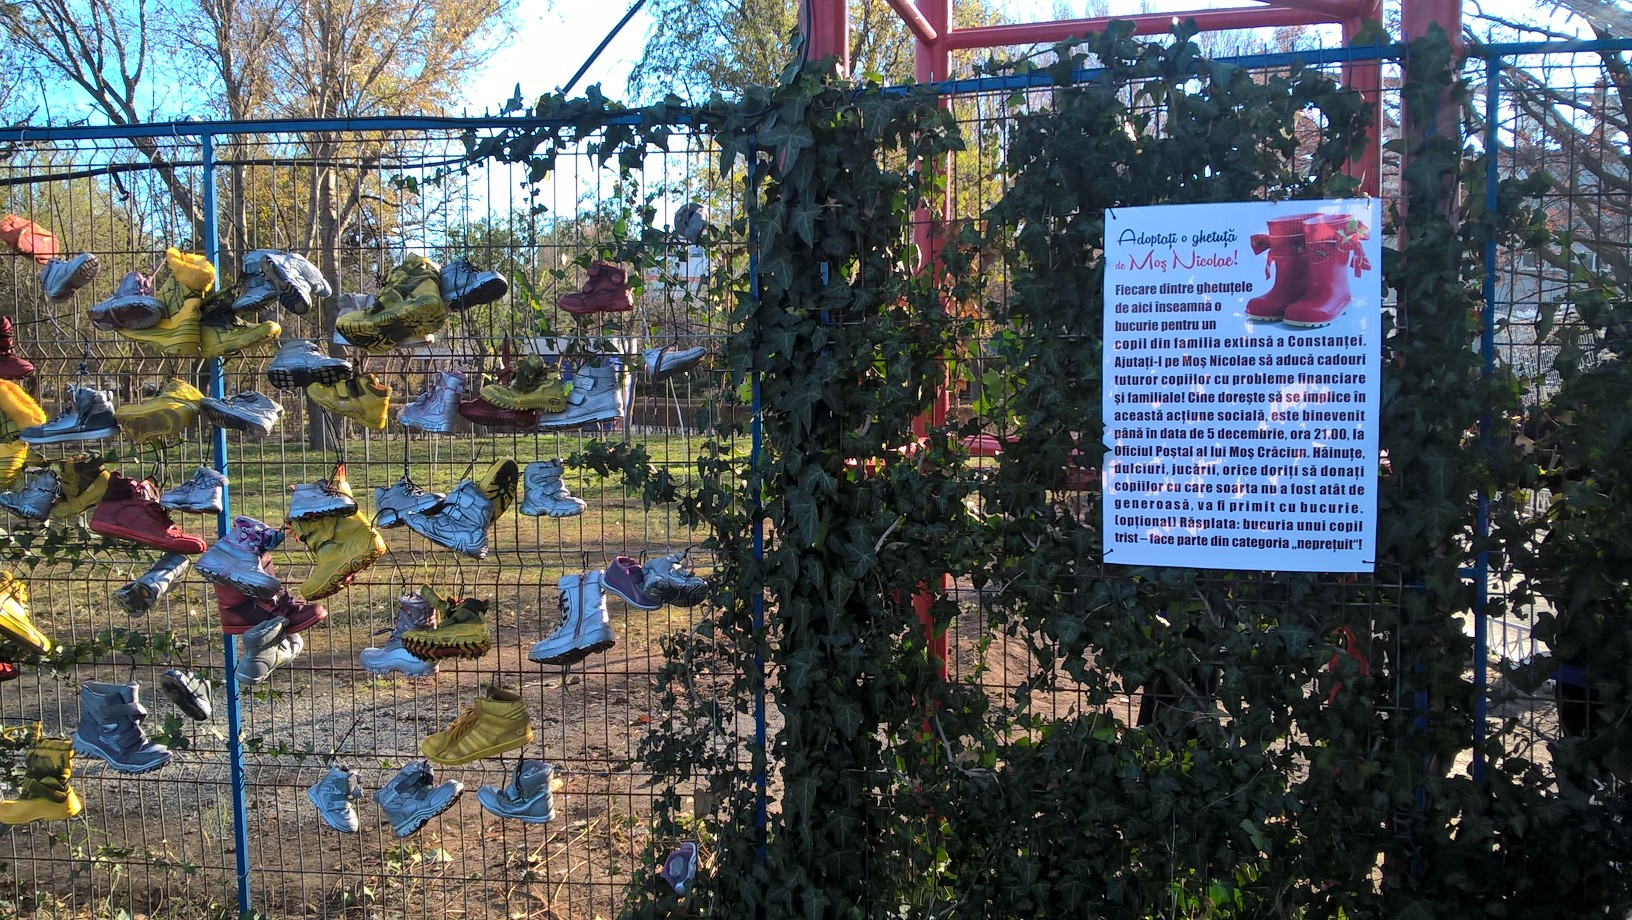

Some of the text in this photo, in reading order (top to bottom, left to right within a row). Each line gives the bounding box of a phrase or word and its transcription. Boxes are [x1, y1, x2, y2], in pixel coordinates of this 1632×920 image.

[1181, 234, 1187, 242] o
[1115, 261, 1125, 270] de
[1172, 249, 1238, 270] Nicolae!
[1116, 284, 1157, 295] Fiecare
[1160, 283, 1194, 294] dintre
[1115, 300, 1221, 313] de aici înseamnă o
[1115, 320, 1216, 332] bucurie pentru un
[1115, 338, 1146, 350] copil
[1151, 338, 1170, 349] din
[1174, 337, 1220, 349] familia
[1224, 336, 1274, 348] extinsă
[1277, 339, 1284, 347] a
[1165, 358, 1179, 368] pe
[1210, 355, 1255, 366] Nicolae
[1259, 354, 1273, 366] să
[1276, 354, 1314, 365] aducă
[1317, 354, 1366, 365] cadouri
[1115, 373, 1366, 386] tuturor copiilor cu probleme financiare
[1127, 392, 1185, 403] familiale!
[1188, 391, 1215, 403] Cine
[1268, 391, 1282, 403] să
[1286, 394, 1300, 403] se
[1303, 391, 1351, 404] implice
[1354, 391, 1366, 403] în
[1115, 409, 1163, 421] această
[1217, 409, 1268, 423] socială,
[1271, 410, 1299, 421] este
[1303, 410, 1365, 421] binevenit
[1115, 427, 1364, 441] până în data de 5 decembrie, ora 21.00, la
[1115, 445, 1152, 456] Oficiul
[1197, 446, 1207, 457] al
[1211, 446, 1227, 457] lui
[1258, 446, 1310, 458] Crăciun.
[1115, 464, 1169, 476] dulciuri,
[1172, 463, 1219, 476] jucării,
[1223, 465, 1257, 475] orice
[1302, 465, 1317, 476] să
[1115, 481, 1364, 495] copiilor cu care soarta nu a fost atât de
[1115, 499, 1363, 513] generoasă, va fi primit cu bucurie.
[1180, 517, 1240, 530] Răsplata:
[1243, 519, 1293, 530] bucuria
[1297, 520, 1326, 531] unui
[1329, 521, 1363, 533] copil
[1115, 532, 1138, 543] trist
[1149, 533, 1175, 544] face
[1178, 535, 1208, 546] parte
[1211, 535, 1229, 546] din
[1232, 536, 1289, 550] categoria
